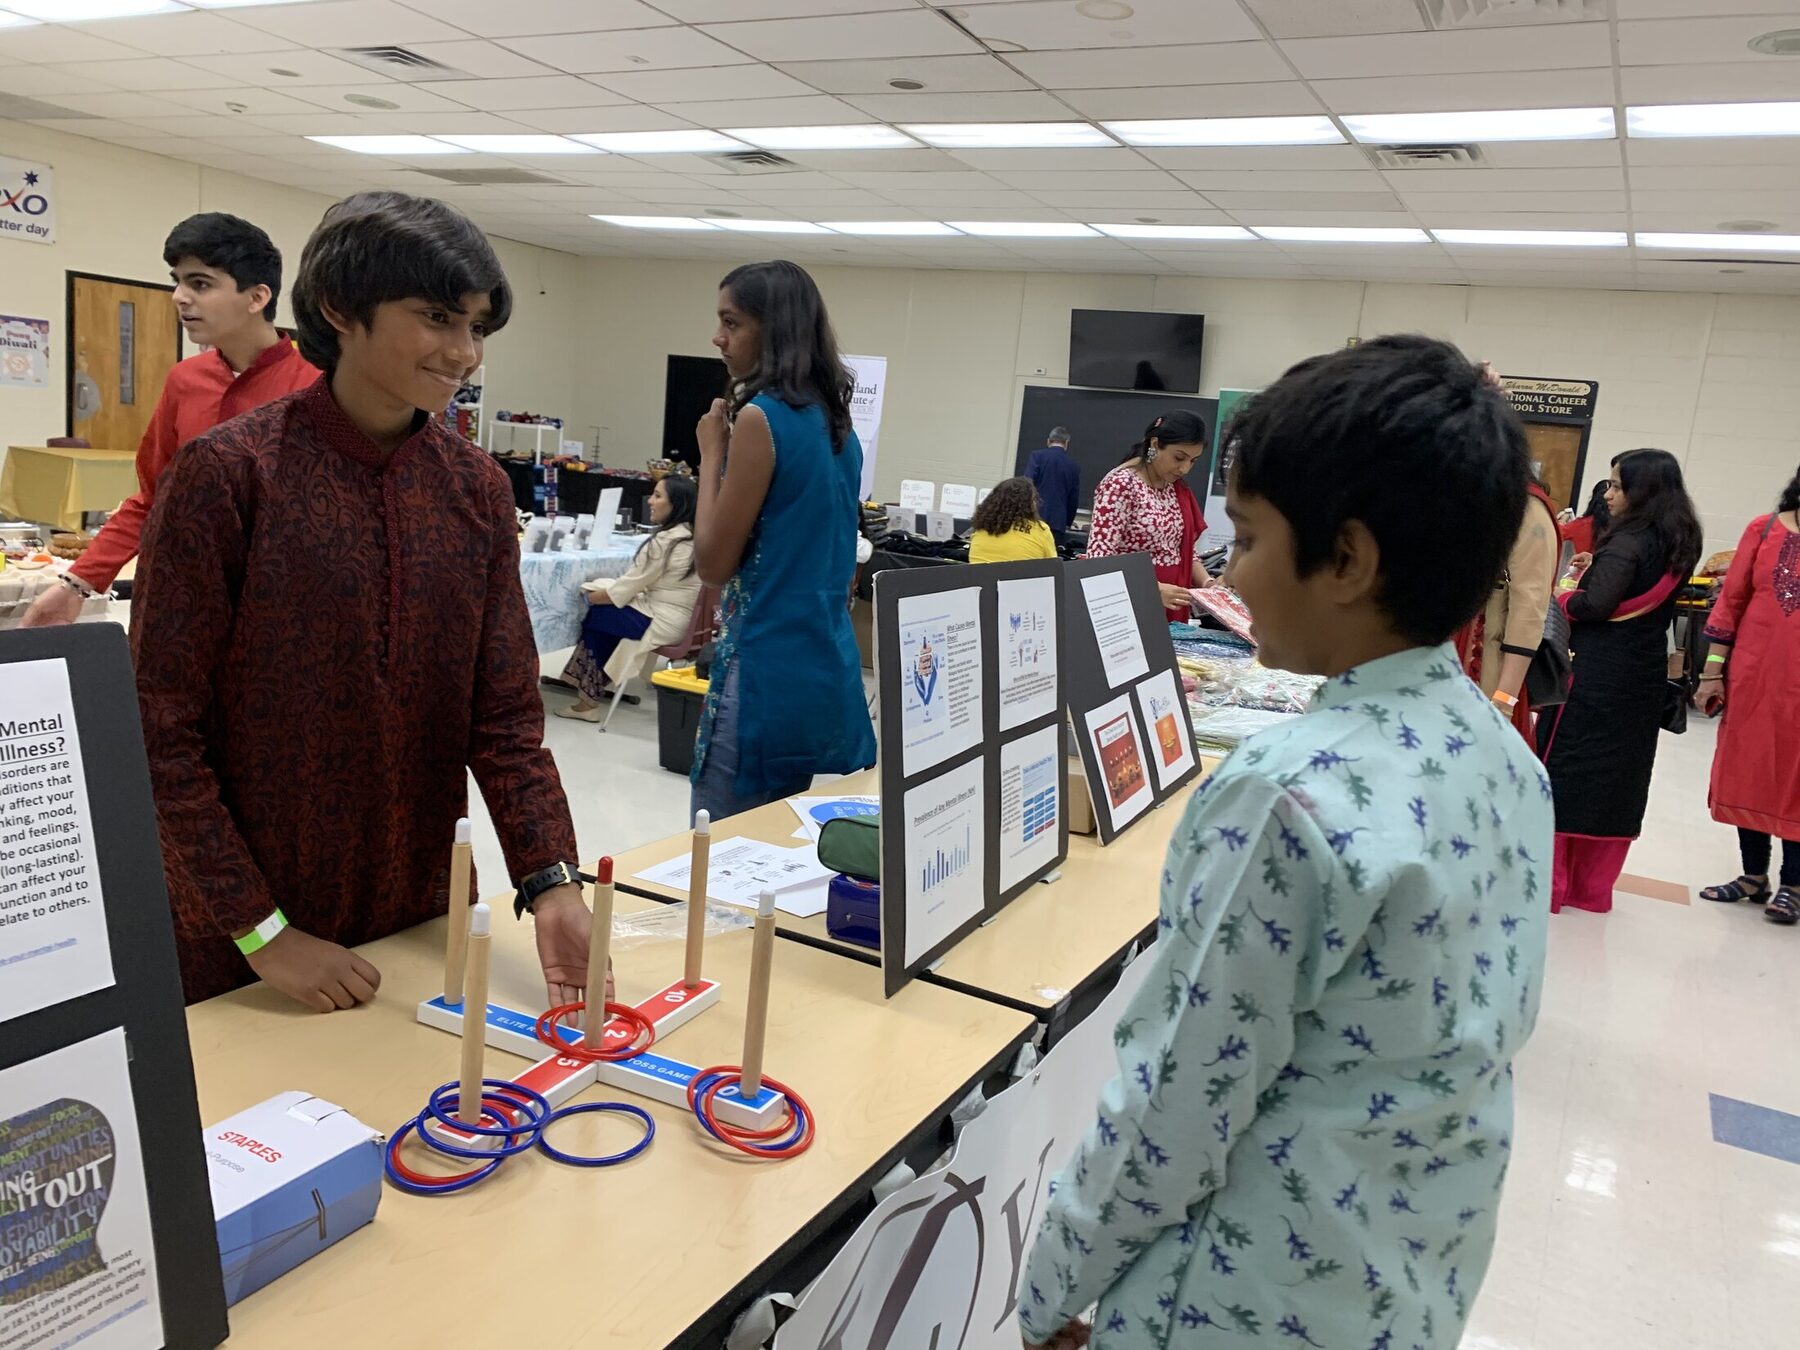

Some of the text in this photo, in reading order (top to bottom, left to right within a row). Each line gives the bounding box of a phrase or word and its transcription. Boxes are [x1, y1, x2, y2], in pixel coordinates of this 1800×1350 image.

[26, 223, 49, 238] day
[0, 337, 37, 349] Diwali
[854, 382, 877, 394] land
[1536, 383, 1581, 394] McDonald
[851, 397, 868, 405] ute
[1538, 404, 1573, 415] STORE
[1548, 395, 1587, 406] CAREER
[0, 713, 63, 737] Mental
[0, 736, 65, 761] Illness?
[0, 760, 70, 781] sorders are
[0, 774, 72, 797] ditions that
[9, 796, 44, 811] affect
[47, 790, 74, 805] your
[38, 803, 77, 820] mood,
[2, 821, 79, 844] and feelings.
[19, 833, 81, 856] occasional
[0, 849, 84, 879] (long-lasting).
[21, 872, 56, 889] affect
[59, 865, 86, 881] your
[50, 882, 72, 897] and
[75, 880, 88, 891] to
[33, 907, 45, 917] to
[49, 896, 91, 913] others.
[664, 990, 688, 1003] 10
[496, 1016, 528, 1029] ELITE
[604, 1029, 627, 1039] 2
[556, 1056, 581, 1068] 5
[627, 1057, 692, 1081] TOSS GAME
[217, 1131, 282, 1163] STAPLES
[44, 1153, 113, 1208] OUT
[4, 1300, 35, 1319] anxiety
